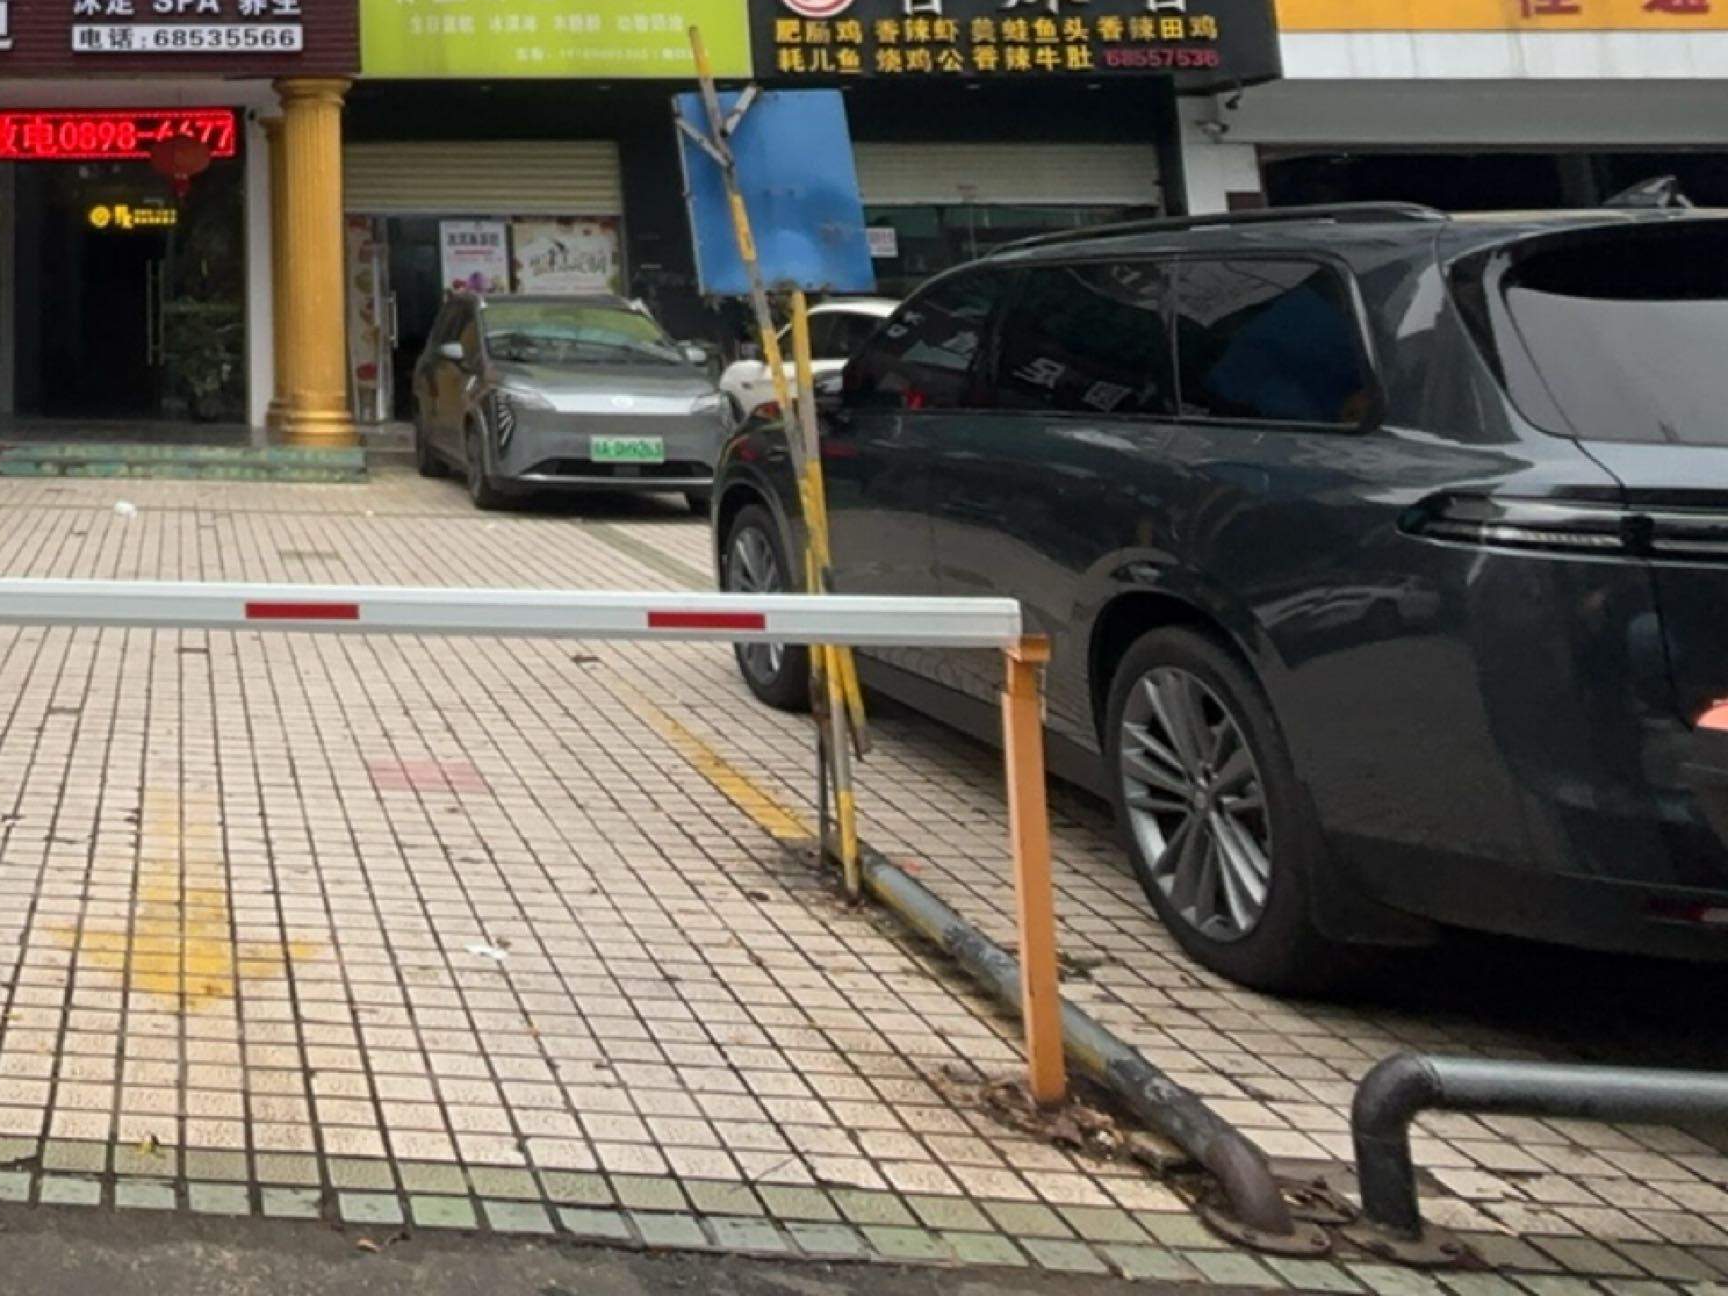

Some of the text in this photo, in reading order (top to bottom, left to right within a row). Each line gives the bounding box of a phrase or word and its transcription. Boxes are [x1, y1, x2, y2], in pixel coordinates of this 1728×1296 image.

[874, 18, 960, 44] 香辣虾
[1096, 14, 1219, 42] 香辣田鸡
[973, 44, 1095, 72] 香辣牛肚
